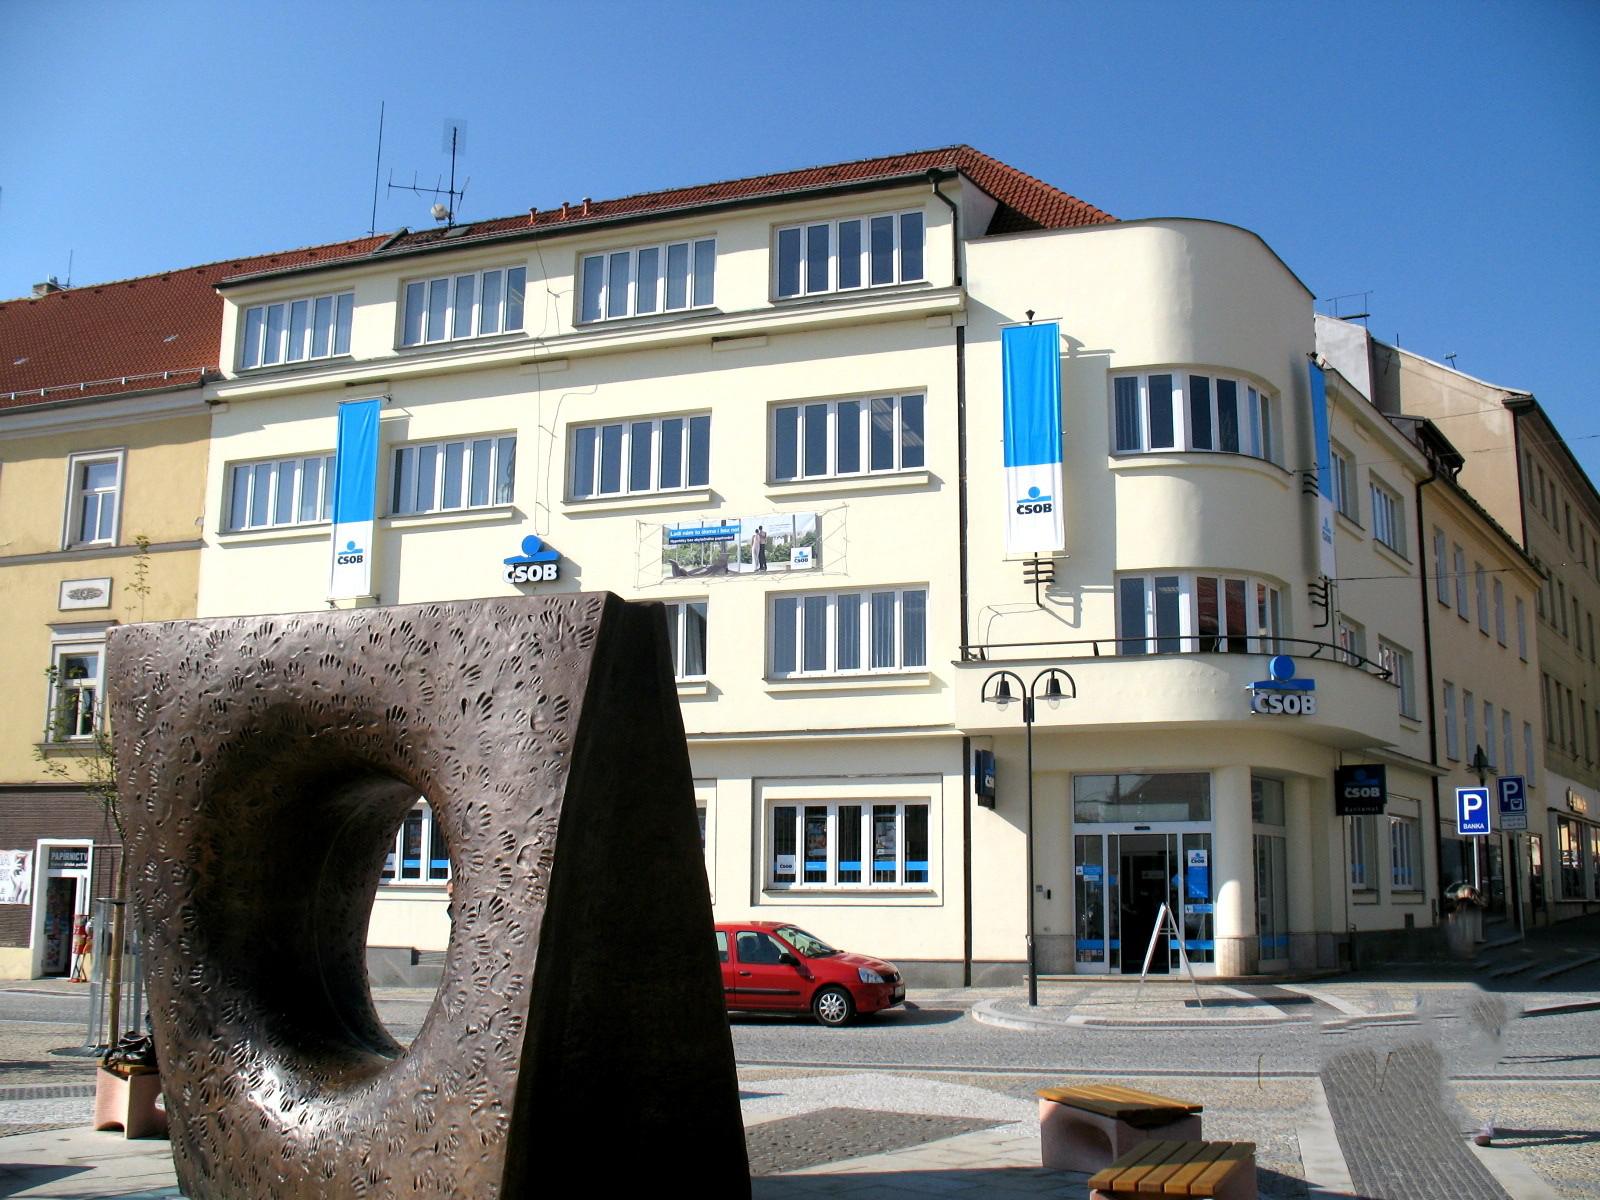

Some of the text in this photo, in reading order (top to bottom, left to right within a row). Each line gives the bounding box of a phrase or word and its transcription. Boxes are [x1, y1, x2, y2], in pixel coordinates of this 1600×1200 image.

[503, 563, 558, 585] ČSOB
[1252, 691, 1317, 715] ČSOB
[1344, 787, 1381, 799] ČSOB
[1502, 781, 1519, 803] P
[1463, 794, 1483, 821] P
[51, 851, 88, 861] PAPÍRNICTV
